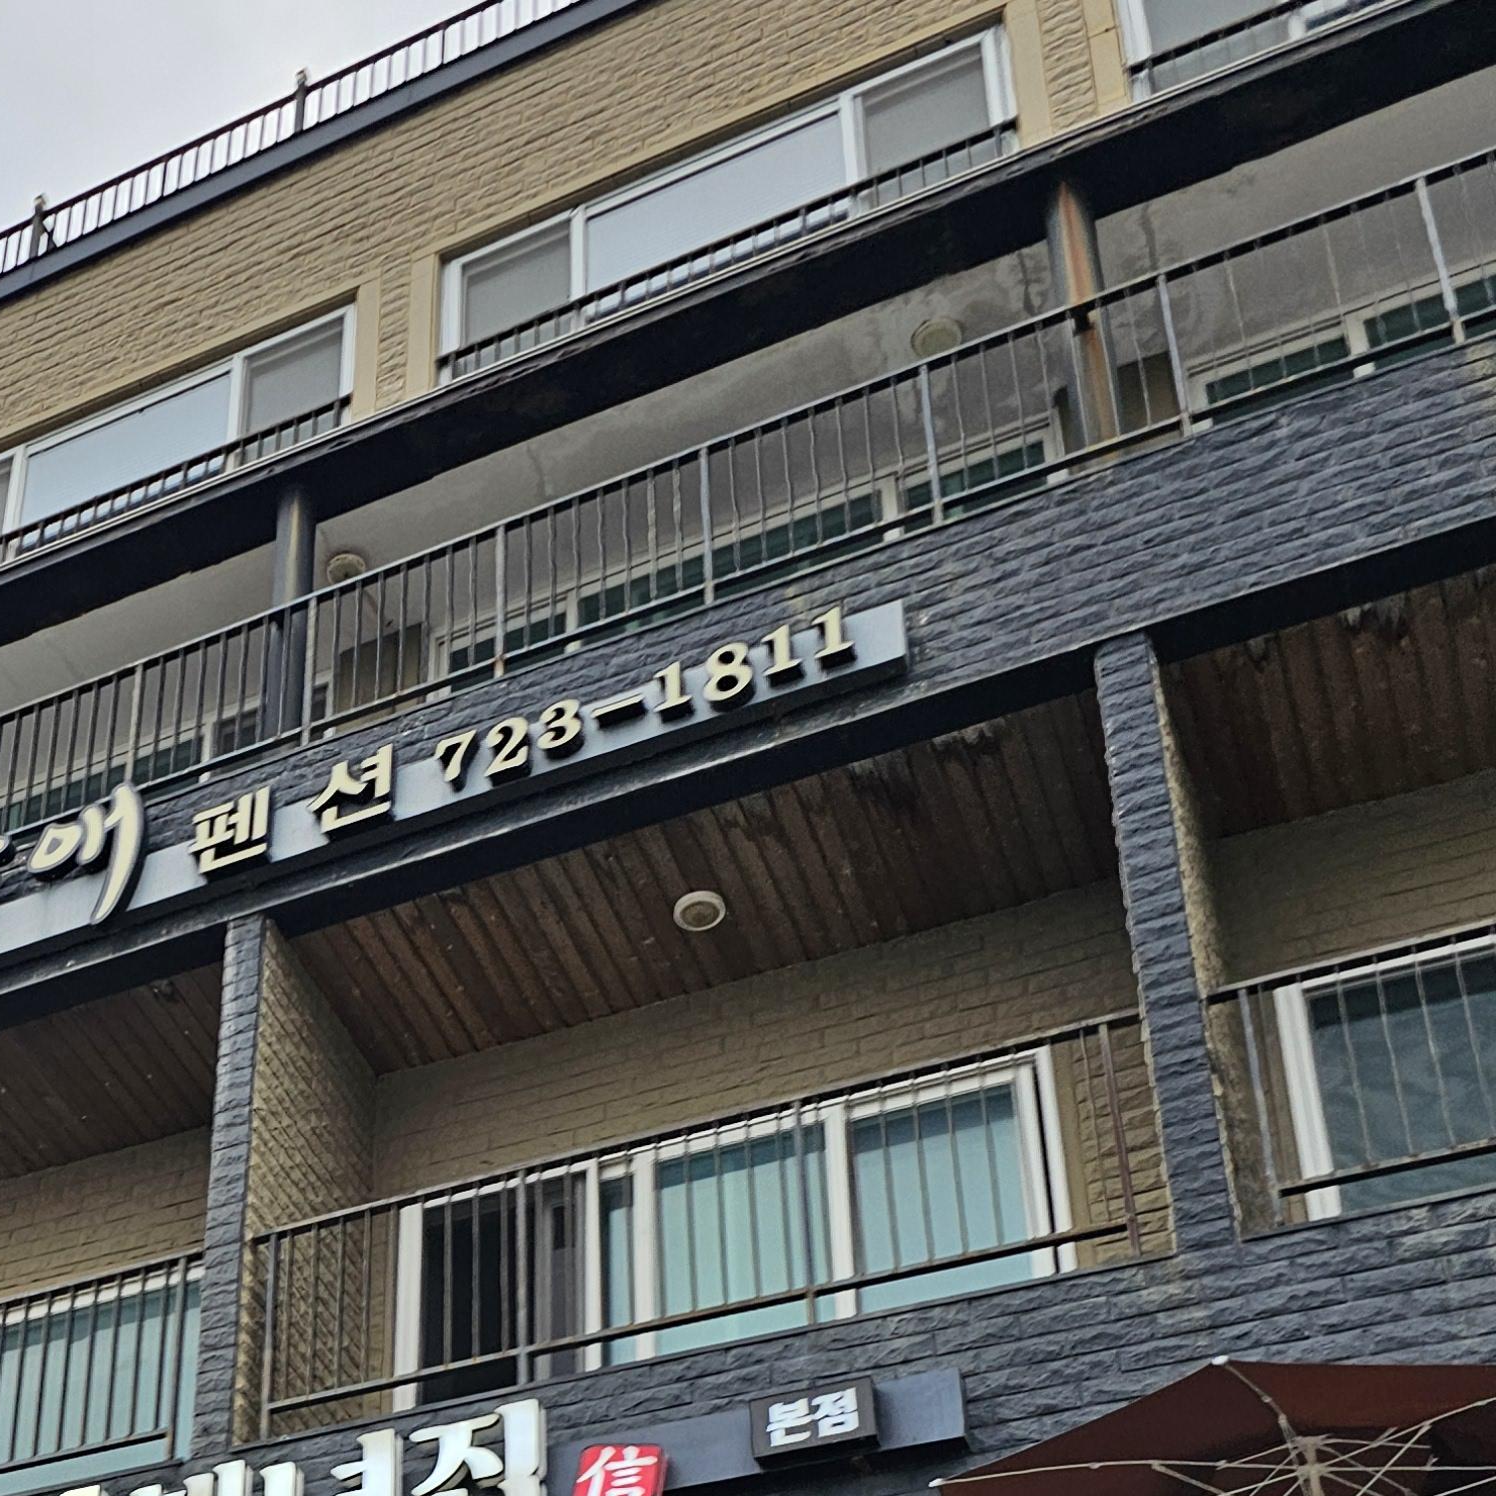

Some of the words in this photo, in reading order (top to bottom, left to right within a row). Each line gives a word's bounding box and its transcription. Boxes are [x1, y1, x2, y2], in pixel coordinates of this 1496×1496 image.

[190, 743, 394, 876] 펜션
[434, 606, 856, 784] 723-1811
[765, 1386, 860, 1448] 본점
